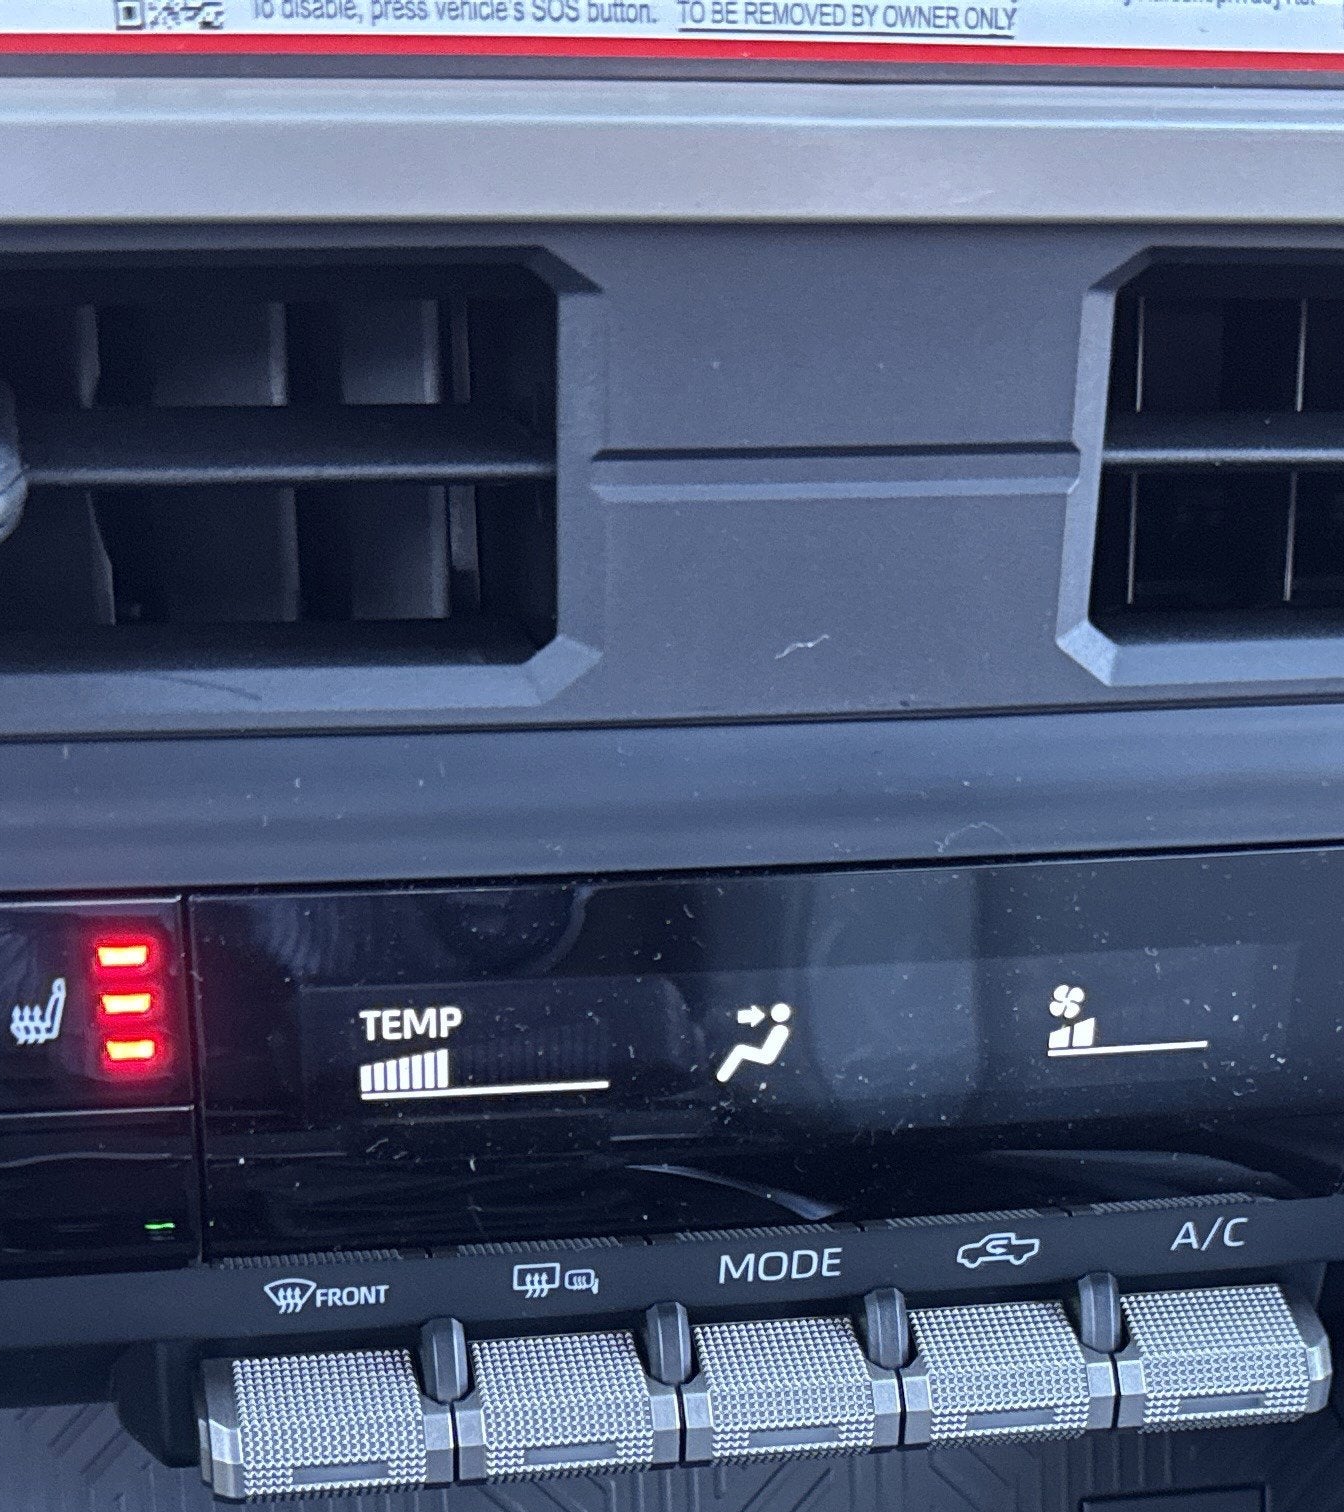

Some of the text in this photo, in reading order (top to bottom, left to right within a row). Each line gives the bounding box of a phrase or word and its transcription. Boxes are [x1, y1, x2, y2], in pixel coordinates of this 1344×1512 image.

[371, 0, 430, 26] press
[434, 0, 526, 21] vehicles
[531, 0, 580, 22] SOS
[586, 0, 658, 24] button.
[676, 0, 1017, 31] TO BE REMOVED BY OWNER ONLY
[358, 1006, 462, 1041] TEMP
[1169, 1216, 1249, 1251] A/C
[718, 1247, 843, 1284] MODE
[315, 1284, 390, 1309] FRONT
